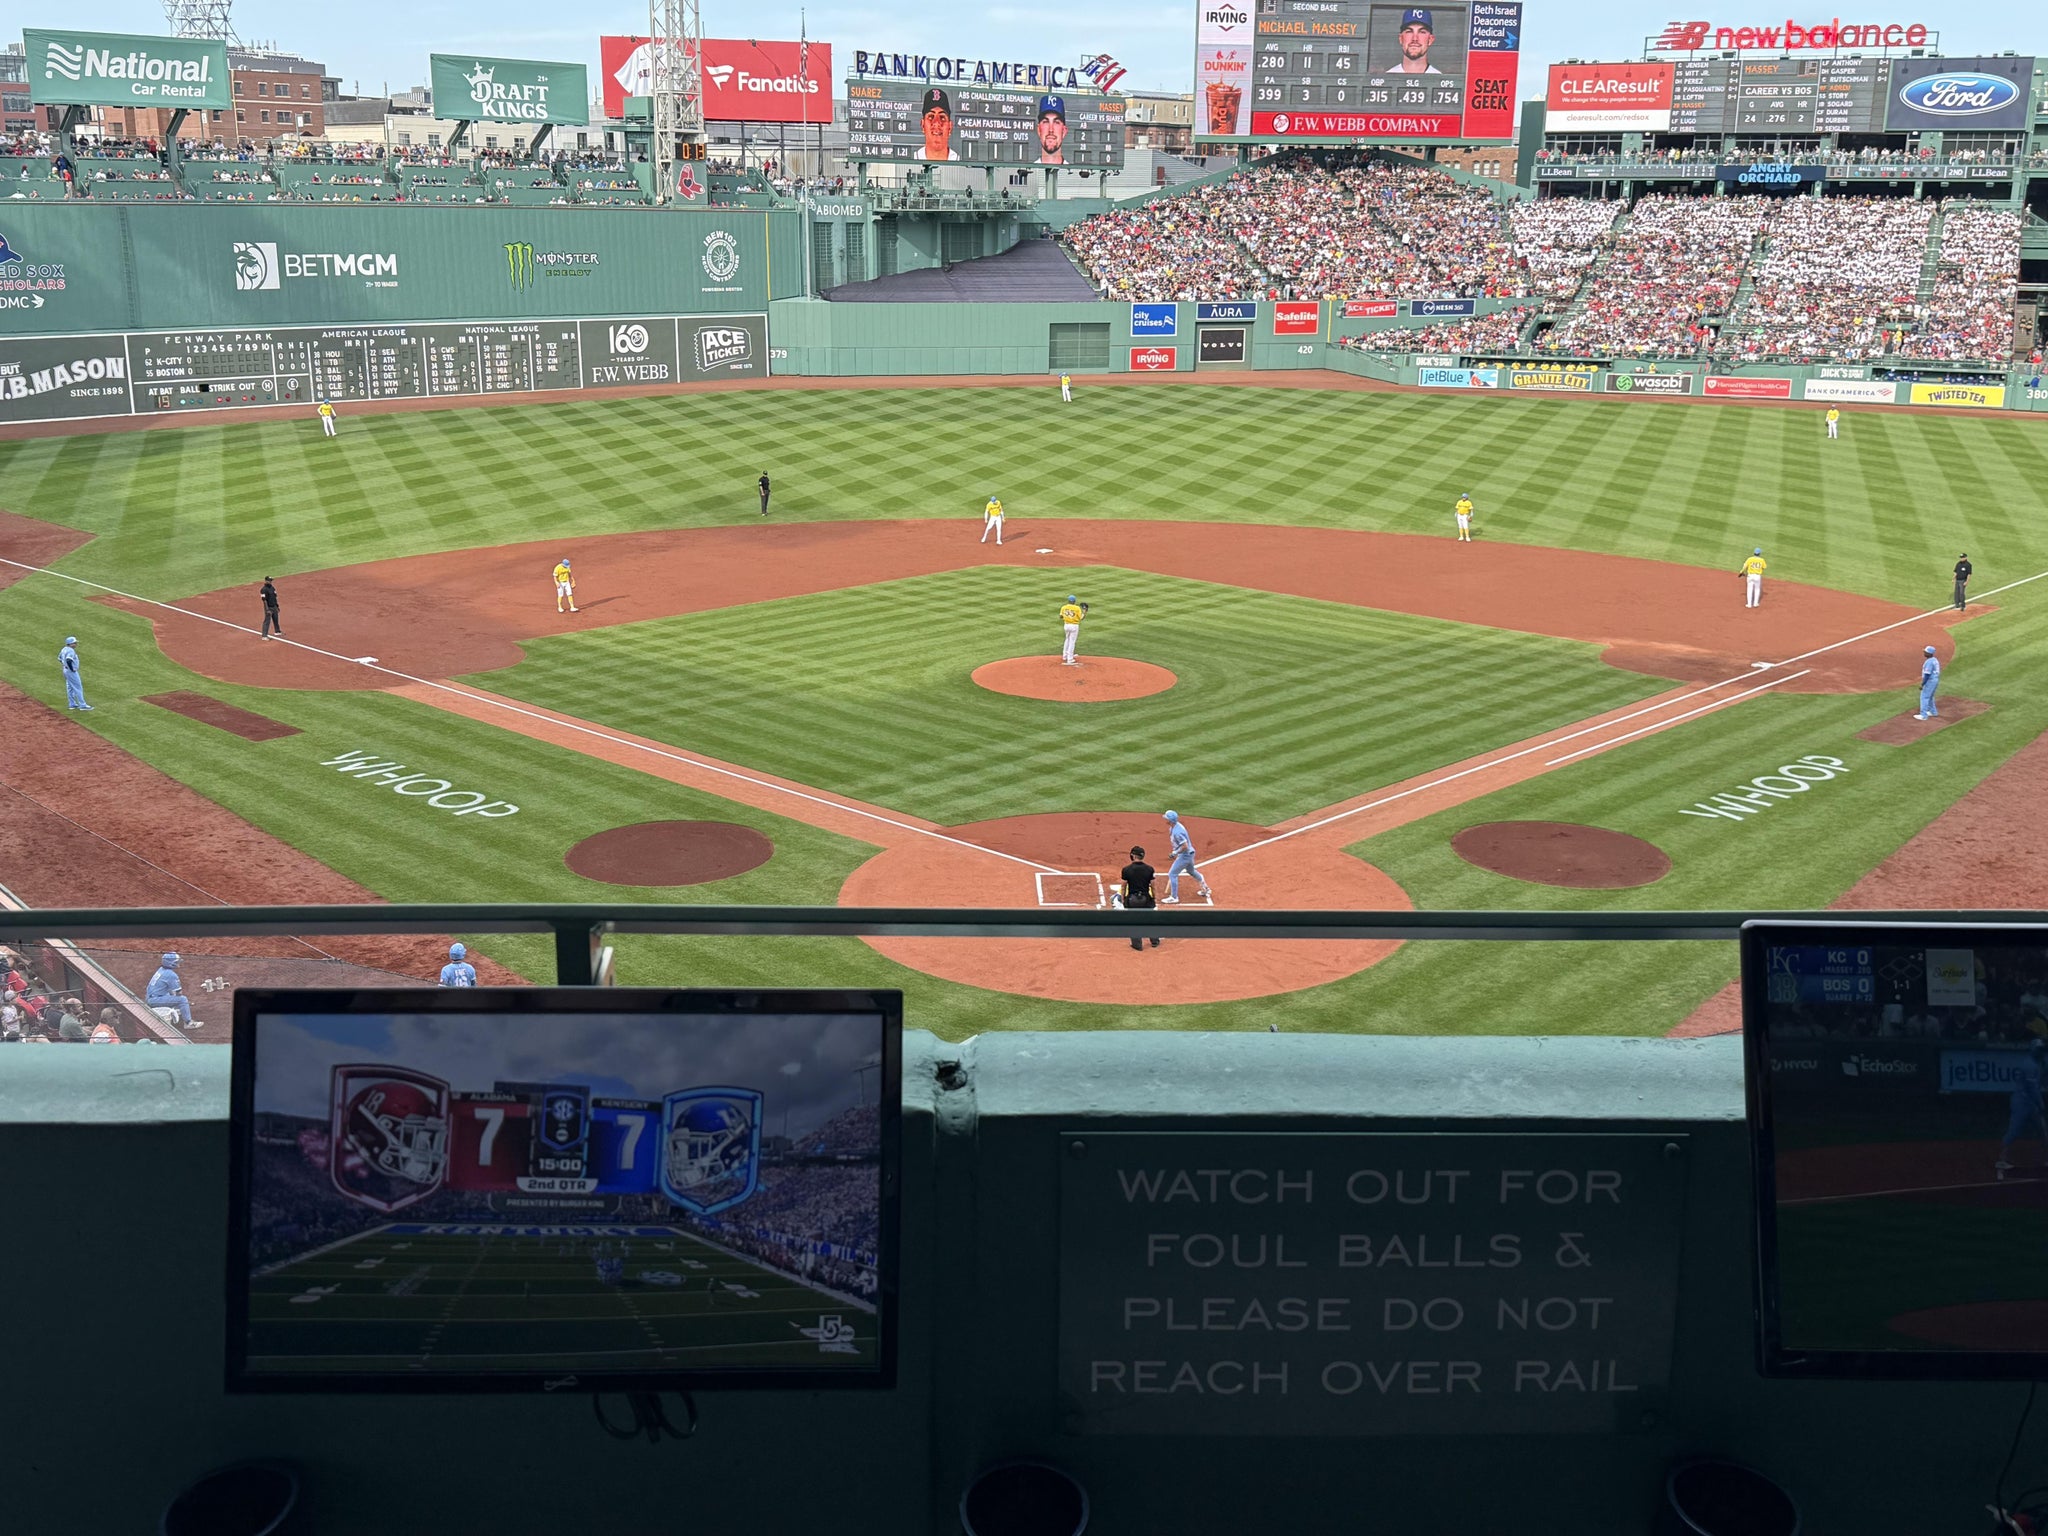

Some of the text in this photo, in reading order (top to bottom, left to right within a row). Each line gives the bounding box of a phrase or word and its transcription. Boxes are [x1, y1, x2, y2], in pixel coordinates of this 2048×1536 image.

[1292, 2, 1338, 12] SECOND BASE
[1474, 4, 1517, 15] Beth Israel
[1206, 12, 1248, 24] IRVING
[1474, 16, 1518, 26] Deaconess
[1258, 21, 1358, 36] MICHAEL MASSEY
[1472, 26, 1505, 37] Medical
[1715, 18, 1927, 50] new balance
[1303, 44, 1313, 52] HR
[1338, 45, 1350, 53] RBI
[1472, 38, 1500, 47] Center
[1204, 62, 1247, 72] DUNKIN'
[1258, 56, 1351, 70] .280 11 45
[855, 50, 1078, 89] BANK OF AMERICA
[1745, 65, 1779, 74] MASSEY
[738, 72, 819, 93] Fanatics
[1302, 77, 1311, 85] SB
[1337, 78, 1347, 86] CS
[1440, 80, 1454, 88] OPS
[1474, 79, 1508, 94] SEAT
[1560, 78, 1660, 94] CLEAResult
[131, 82, 206, 97] Car Rental
[470, 81, 548, 102] DRAFT
[850, 87, 882, 98] SUAREZ
[1745, 87, 1812, 95] CAREER VS BOS
[1922, 78, 1995, 107] Ford
[971, 92, 1005, 101] CHALLENGES
[1258, 88, 1459, 104] 399 3 0 .315 .439 .754
[850, 100, 913, 111] TODAY'S PITCH COUNT
[1099, 103, 1125, 112] MASSEY
[1472, 95, 1508, 110] GEEK
[482, 99, 548, 119] KINGS
[958, 118, 1011, 129] 4-SEAM FASTBALL
[1566, 114, 1650, 122] clearesult.com/redsox
[1294, 118, 1442, 132] F.W. WEBB COMPANY
[960, 130, 980, 138] BALLS
[985, 131, 1008, 139] STRIKES
[1541, 168, 1572, 176] L.L.Bean
[1748, 163, 1791, 173] ANGRY
[1971, 168, 2008, 177] L.L.Bean
[1738, 173, 1801, 183] ORCHARD
[816, 204, 862, 216] ABIOMED
[703, 231, 737, 247] IBEW 103
[536, 251, 600, 266] MONSTER
[0, 264, 65, 278] ED SOX
[284, 253, 398, 277] BETMGM
[0, 279, 66, 291] HOLARS
[1134, 311, 1149, 320] city
[1365, 304, 1396, 315] TICKET
[1276, 312, 1317, 321] Safelite
[322, 330, 368, 338] AMERICAN
[465, 325, 539, 334] NATIONAL LEAGUE
[165, 333, 272, 344] FENWAY PARK
[609, 324, 649, 354] 160
[706, 330, 745, 350] ACE
[706, 346, 745, 361] TICKET
[770, 350, 787, 358] 379
[1298, 345, 1313, 354] 420
[156, 357, 182, 365] K-CITY
[1137, 355, 1168, 363] IRVING
[0, 365, 20, 375] BUT
[156, 368, 185, 377] BOSTON
[592, 364, 669, 383] F.W. WEBB
[1820, 367, 1848, 378] DICK'S
[1424, 370, 1464, 384] jetBlue
[1513, 374, 1590, 388] GRANITE CITY
[1634, 375, 1683, 388] wasabi
[70, 386, 124, 397] SINCE 1898
[148, 388, 158, 396] AT
[160, 387, 173, 395] BAT
[180, 386, 200, 394] BALL
[209, 384, 236, 392] STRIKE
[2026, 389, 2048, 399] 380
[1928, 390, 1986, 404] TWISTED TEA
[320, 750, 520, 817] WHOOP
[1678, 755, 1850, 821] WHOOP
[1827, 949, 1869, 965] KC 0
[1823, 978, 1870, 993] BOS 0
[1949, 1060, 2025, 1086] jetBlue
[474, 1107, 505, 1166] 7
[616, 1115, 646, 1170] 7
[538, 1158, 582, 1171] 15:00
[527, 1179, 586, 1190] 2nd QTR
[1117, 1169, 1623, 1204] WATCH OUT FOR
[1146, 1232, 1593, 1269] FOUL BALLS &
[1124, 1298, 1613, 1330] PLEASE DO NOT
[1090, 1360, 1638, 1395] REACH OVER RAIL
